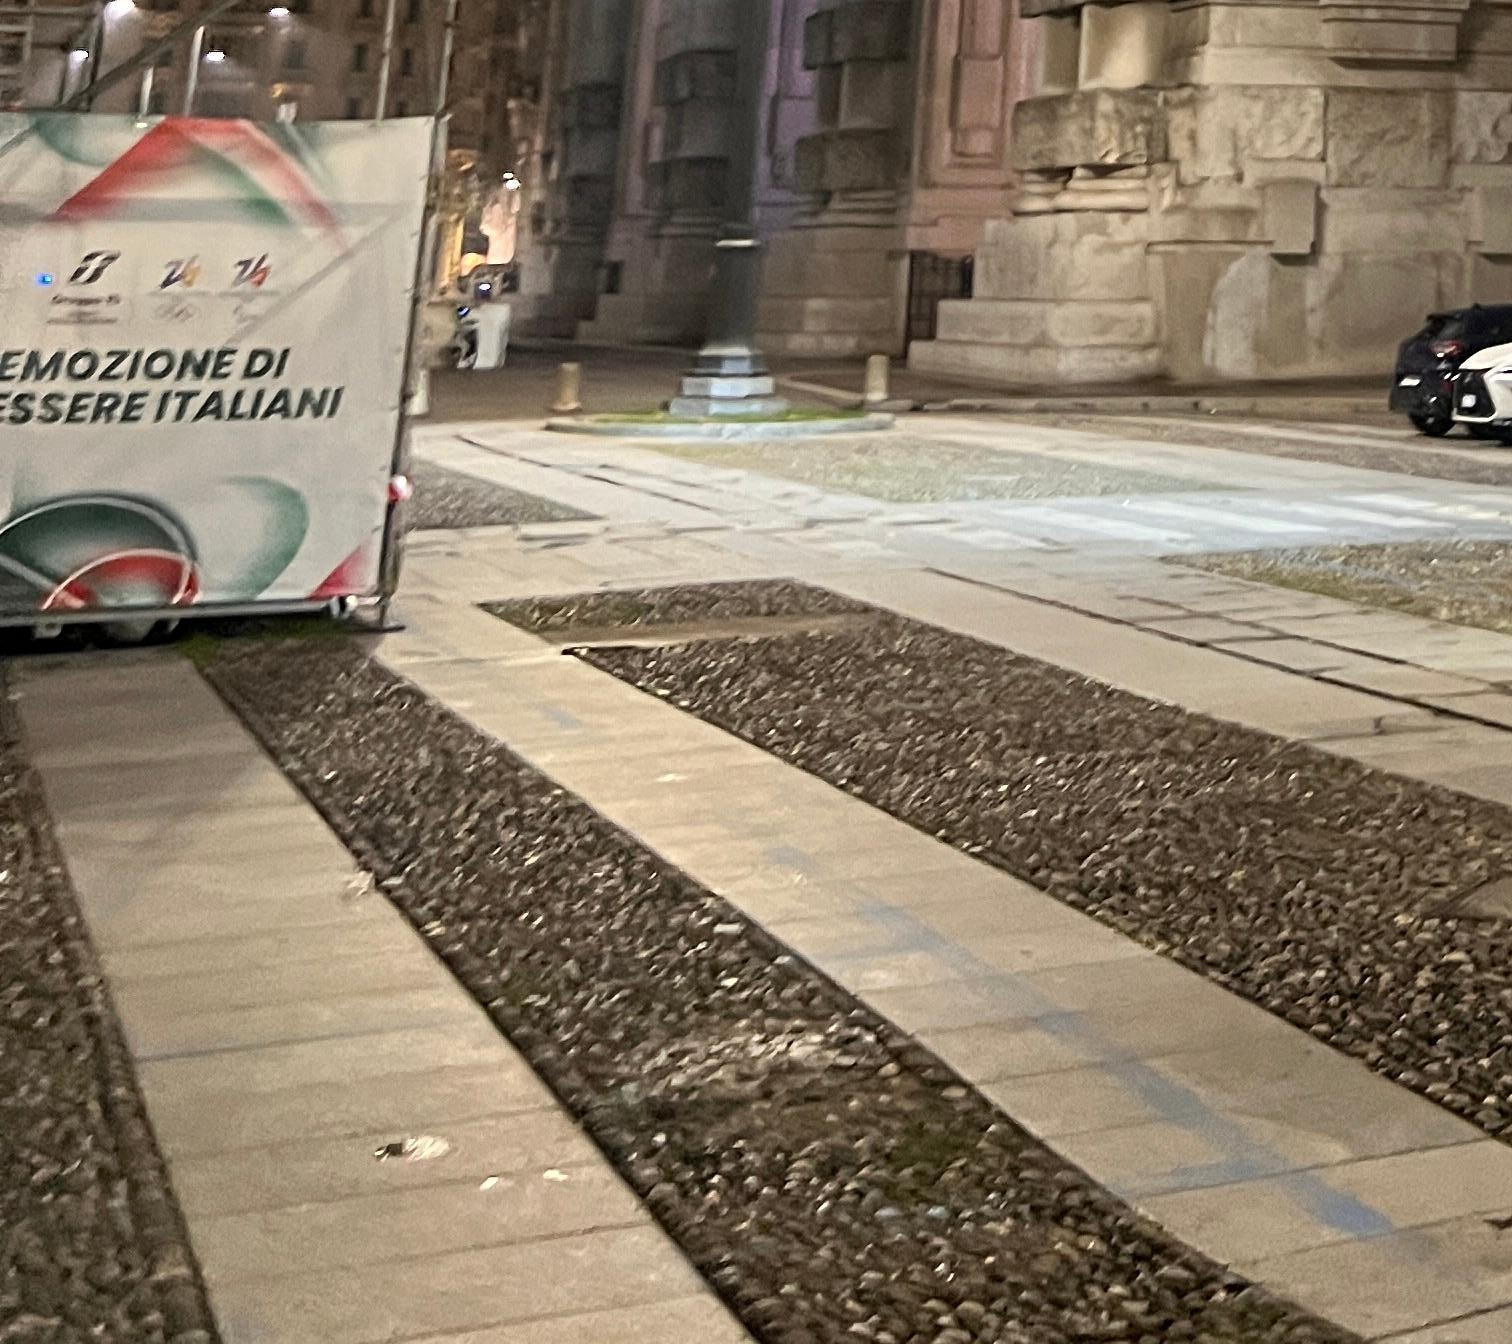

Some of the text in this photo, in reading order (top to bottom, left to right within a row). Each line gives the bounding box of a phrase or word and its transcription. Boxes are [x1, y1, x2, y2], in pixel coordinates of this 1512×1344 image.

[0, 348, 291, 382] EMOZIONE DI
[154, 385, 345, 424] ITALIANI
